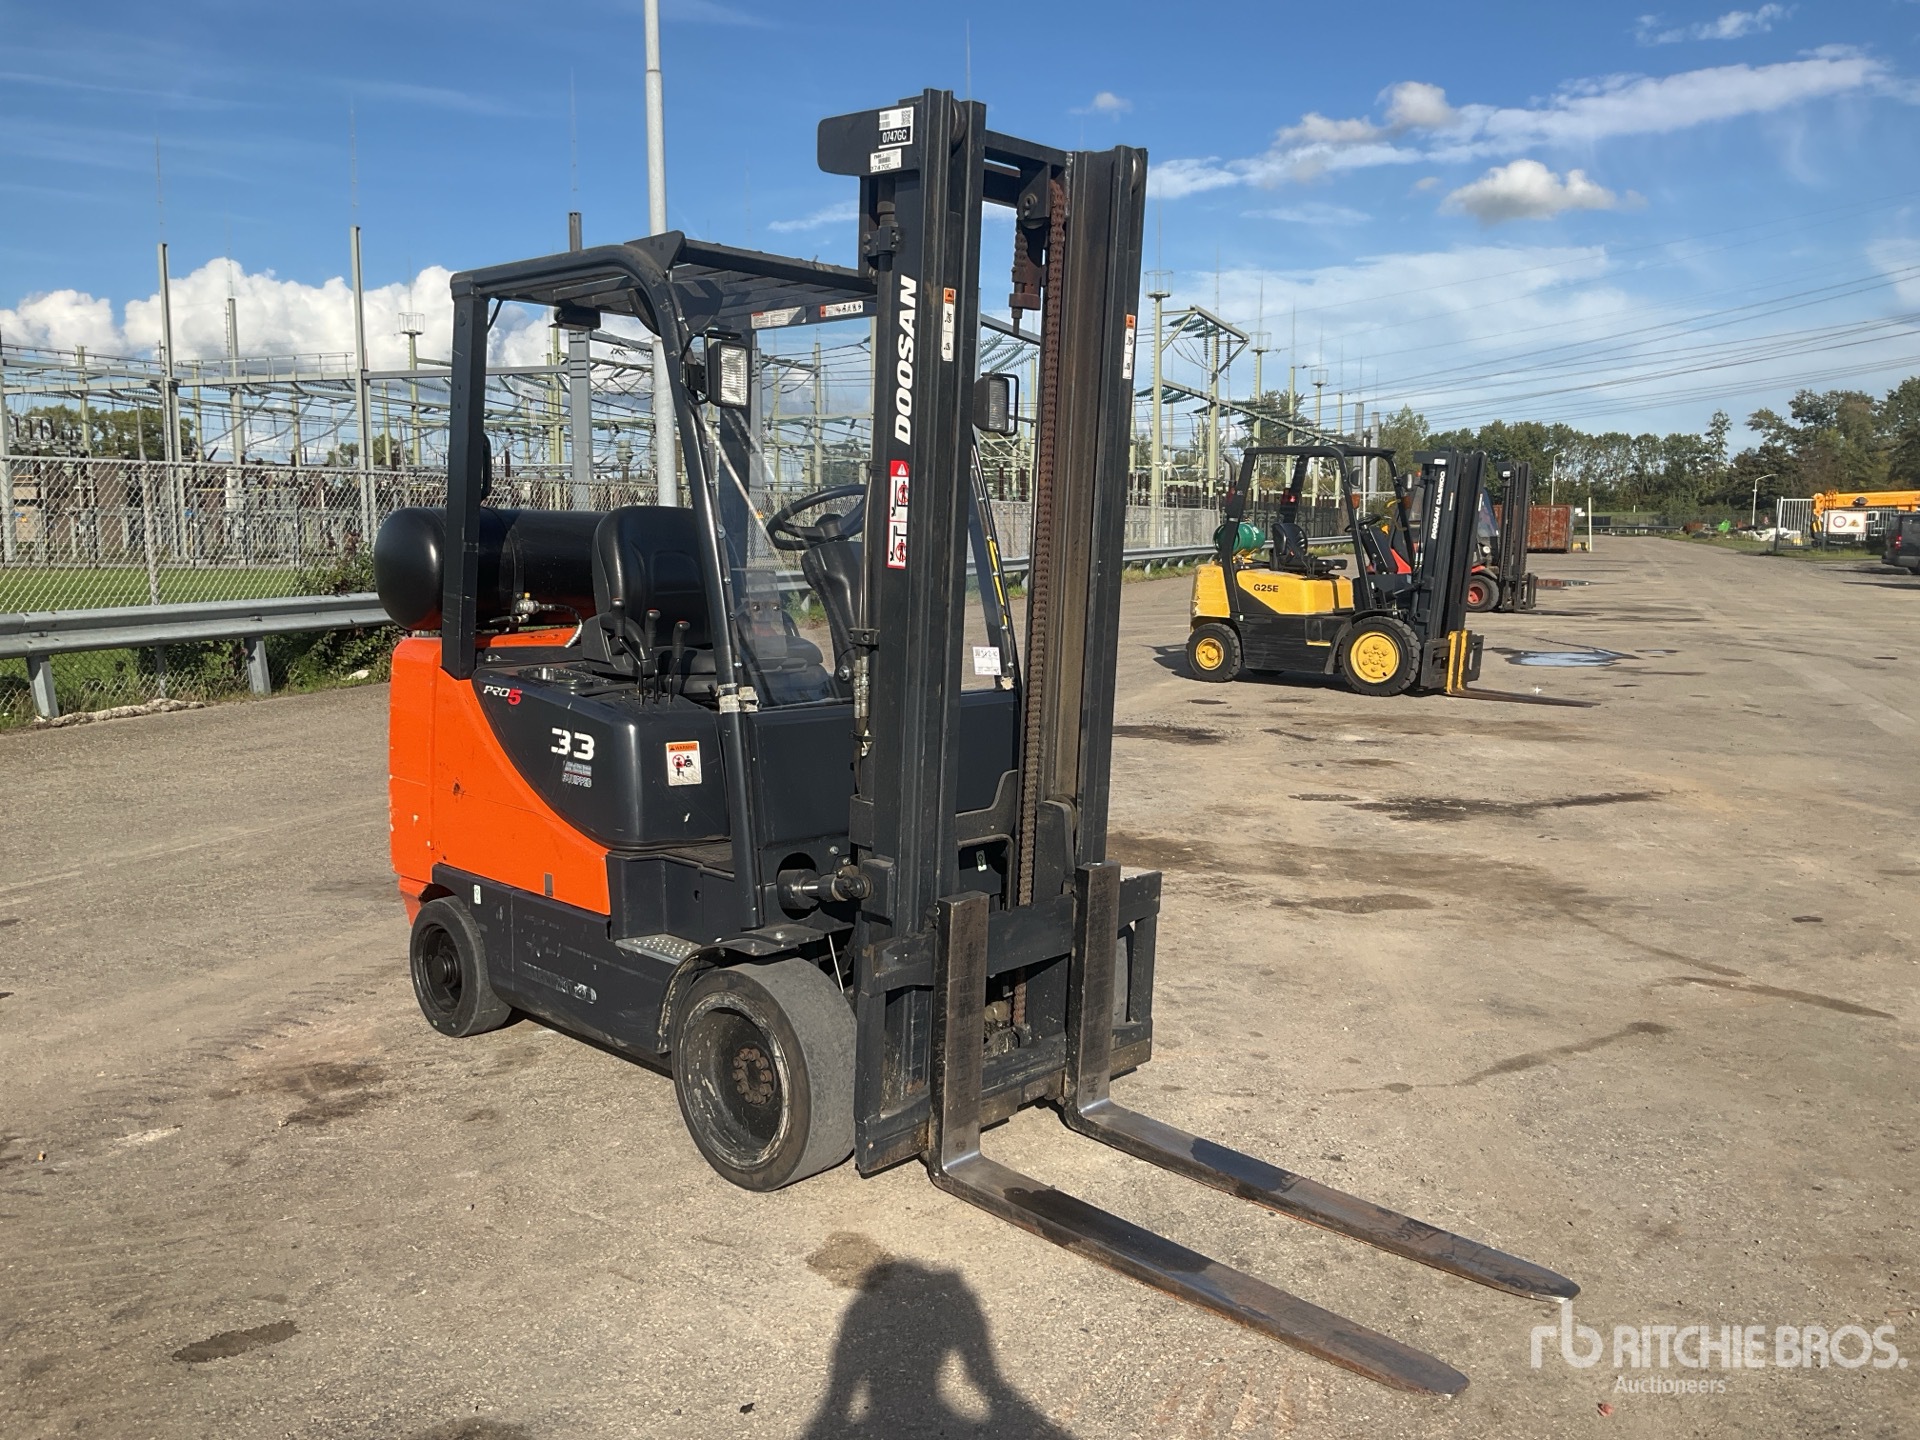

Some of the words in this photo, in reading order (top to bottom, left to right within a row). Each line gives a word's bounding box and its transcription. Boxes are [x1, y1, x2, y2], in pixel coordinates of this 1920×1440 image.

[882, 129, 907, 143] 0747GC
[894, 274, 917, 446] DOOSAN
[1431, 506, 1441, 540] DOOSAN
[1436, 471, 1445, 505] DAEWOO
[1253, 583, 1279, 593] G25E
[483, 685, 523, 706] PRO5
[550, 727, 595, 761] 33
